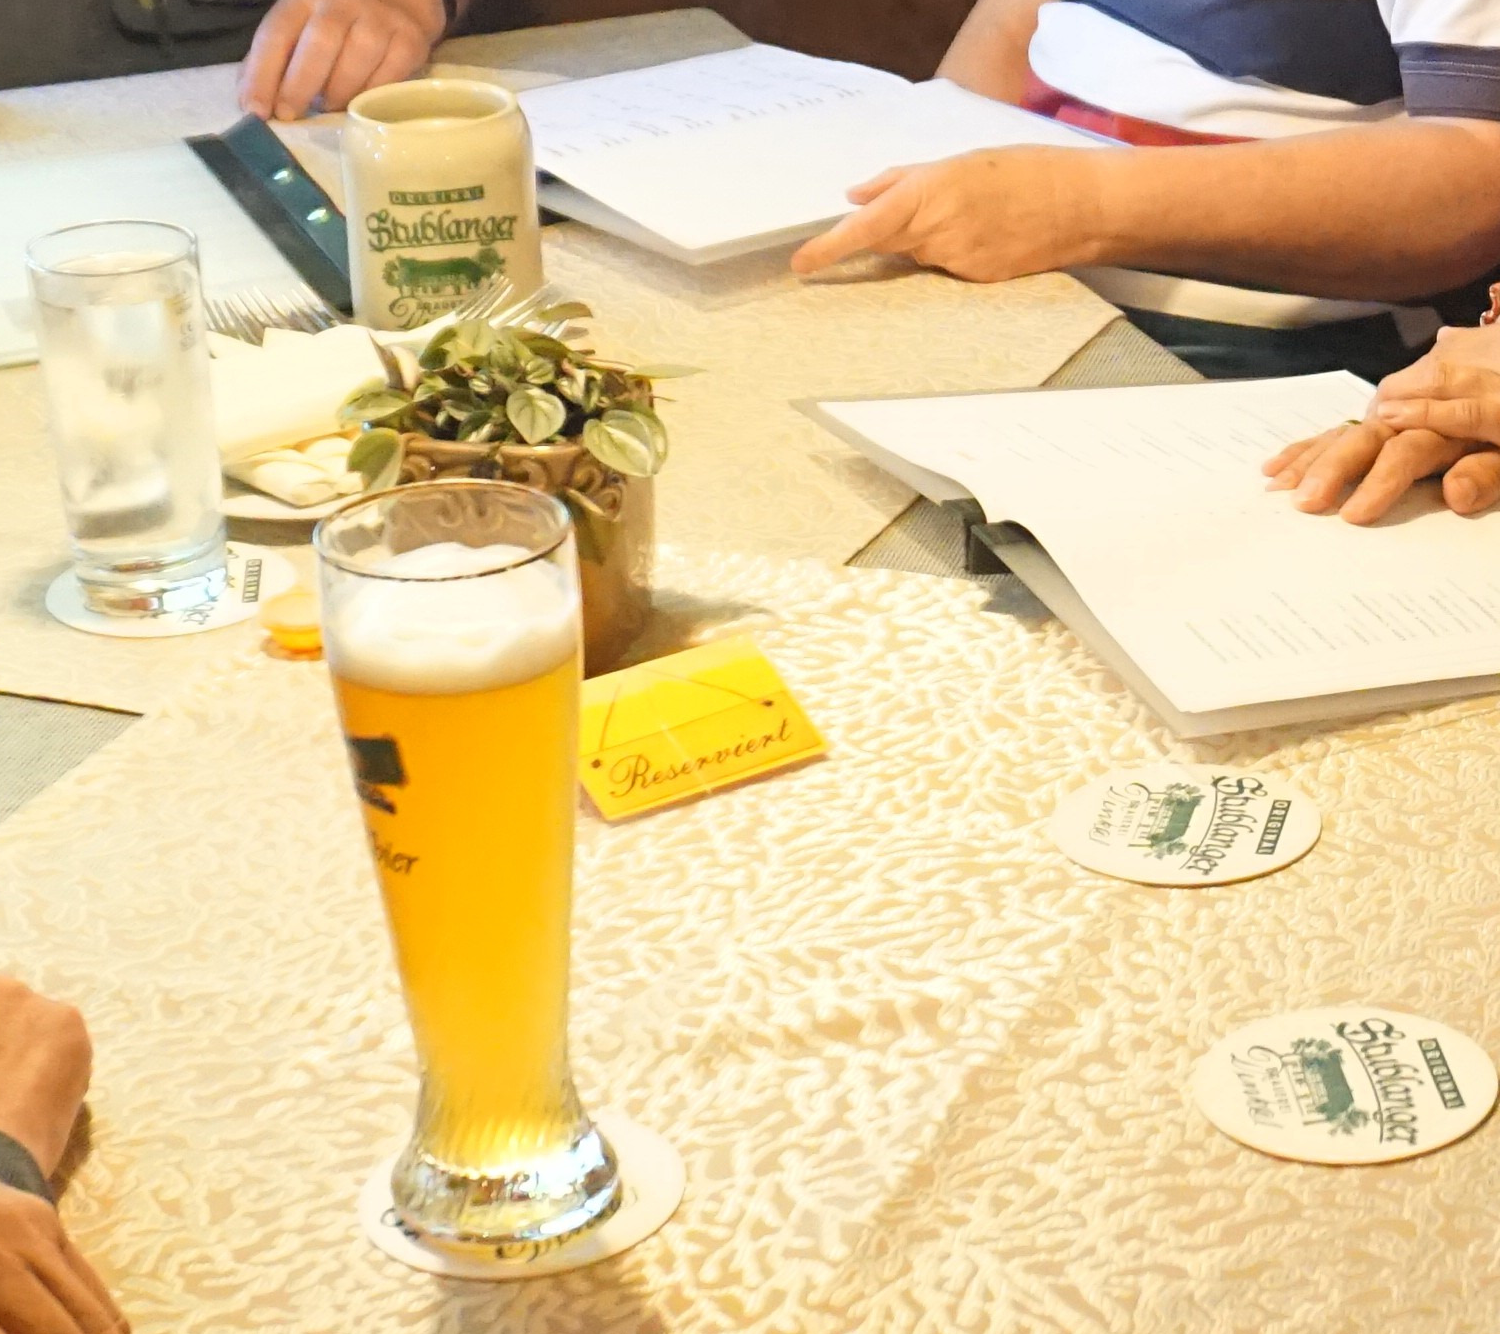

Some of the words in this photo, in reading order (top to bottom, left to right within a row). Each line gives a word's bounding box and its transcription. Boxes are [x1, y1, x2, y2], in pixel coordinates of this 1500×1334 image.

[390, 186, 483, 205] ORIGINAL
[366, 208, 517, 252] Stublanger
[610, 717, 793, 798] Reserviert
[1089, 782, 1151, 847] Dinkel
[1118, 800, 1142, 837] BRAUEREI
[1190, 775, 1267, 876] Stublanger
[1256, 800, 1291, 855] ORIGINAL
[1231, 1045, 1284, 1130] Dinkel
[1330, 1018, 1419, 1146] Stublanger
[1418, 1038, 1465, 1110] ORIGINAL
